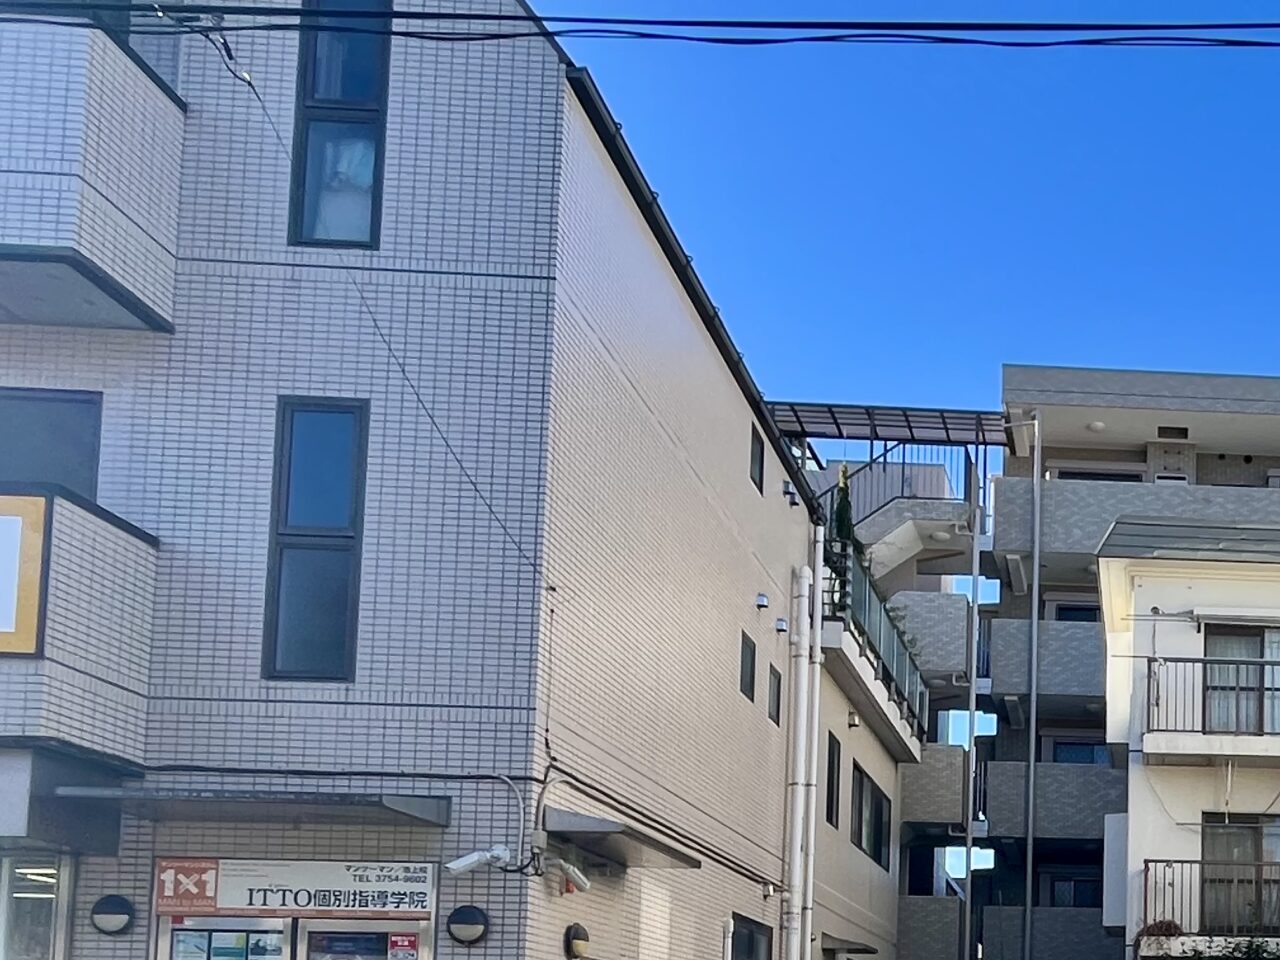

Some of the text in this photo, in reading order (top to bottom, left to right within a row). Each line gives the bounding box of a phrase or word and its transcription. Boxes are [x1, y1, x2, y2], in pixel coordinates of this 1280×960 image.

[352, 873, 371, 883] TEL
[246, 887, 429, 908] ITTO個別指導学院
